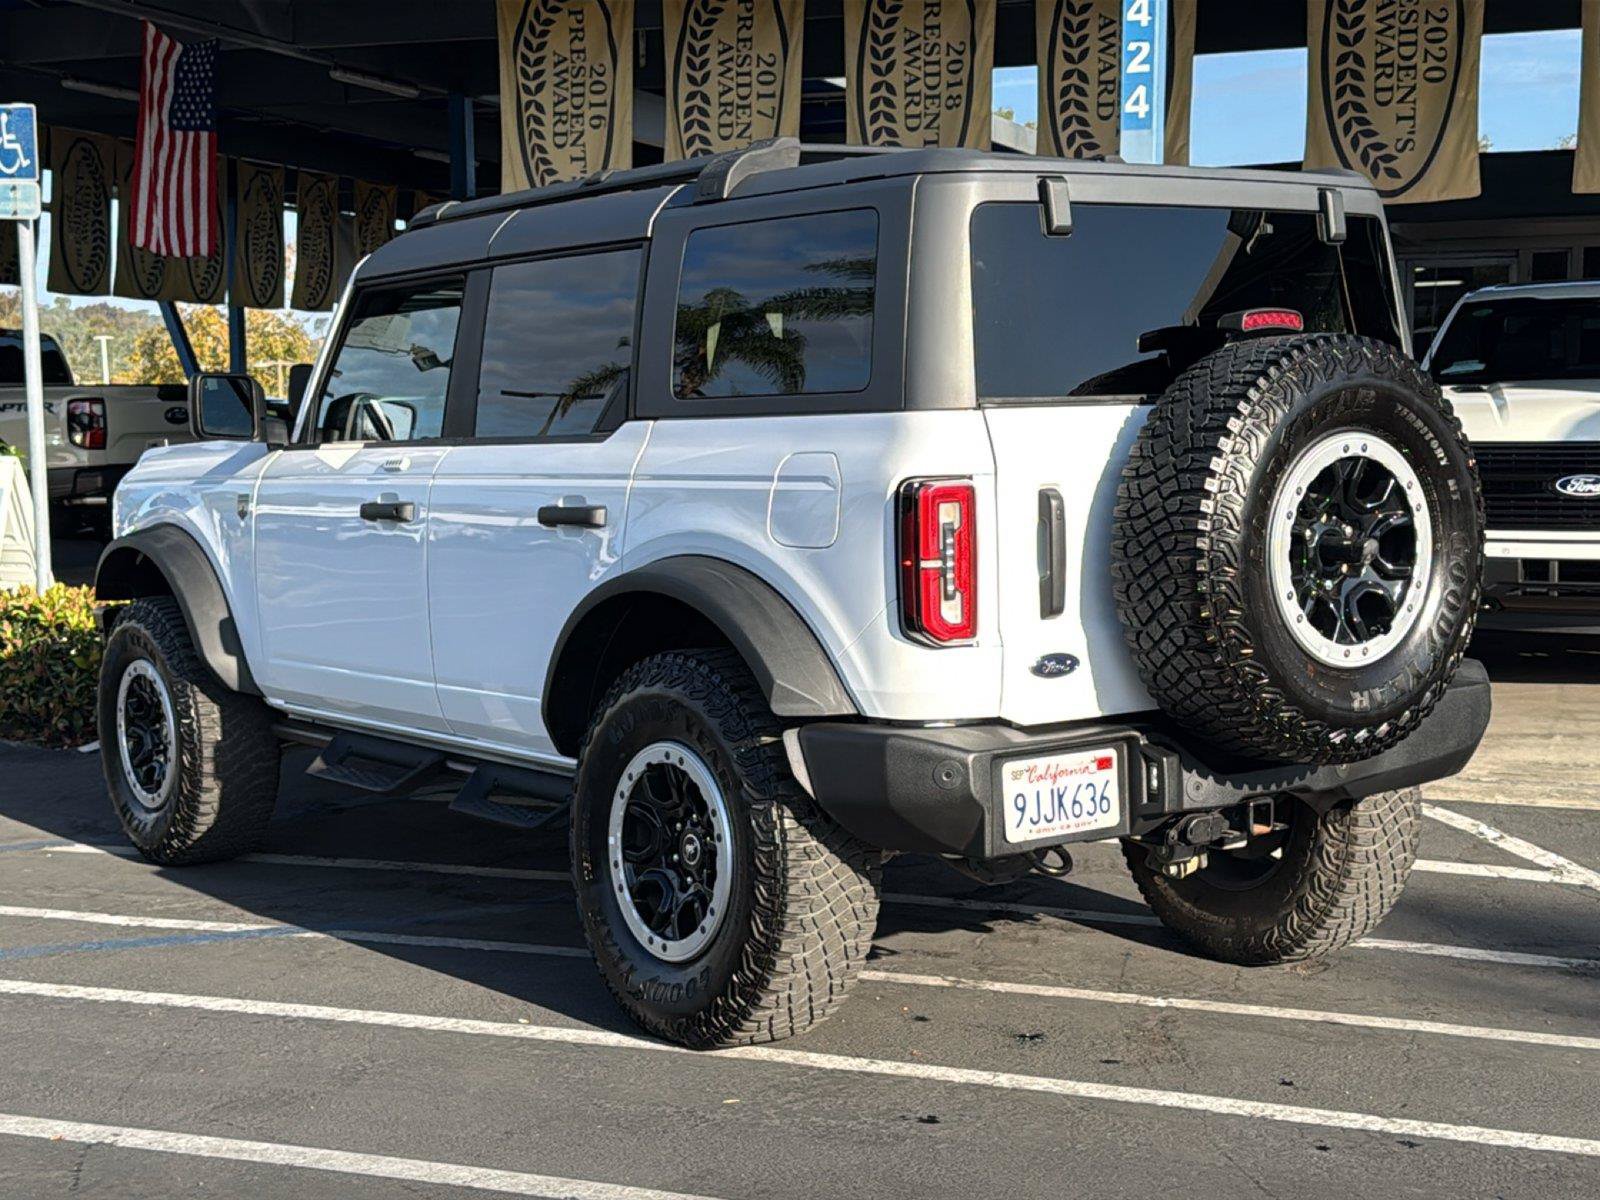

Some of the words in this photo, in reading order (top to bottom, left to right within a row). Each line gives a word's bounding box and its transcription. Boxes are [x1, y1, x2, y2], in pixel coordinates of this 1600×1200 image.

[736, 0, 754, 146] PRESIDEN
[756, 53, 777, 120] 2017
[903, 26, 921, 132] AWARD
[944, 41, 967, 111] 2018
[1096, 13, 1118, 121] AWARD
[1374, 0, 1396, 107] AWARD
[1422, 7, 1450, 84] 2020
[553, 49, 569, 149] AWARD
[568, 8, 587, 179] PRESIDENT'
[589, 63, 608, 130] 2016
[717, 39, 735, 141] AWARD
[0, 402, 57, 414] PTR
[1013, 779, 1110, 829] 9JJK636
[1024, 763, 1097, 785] California
